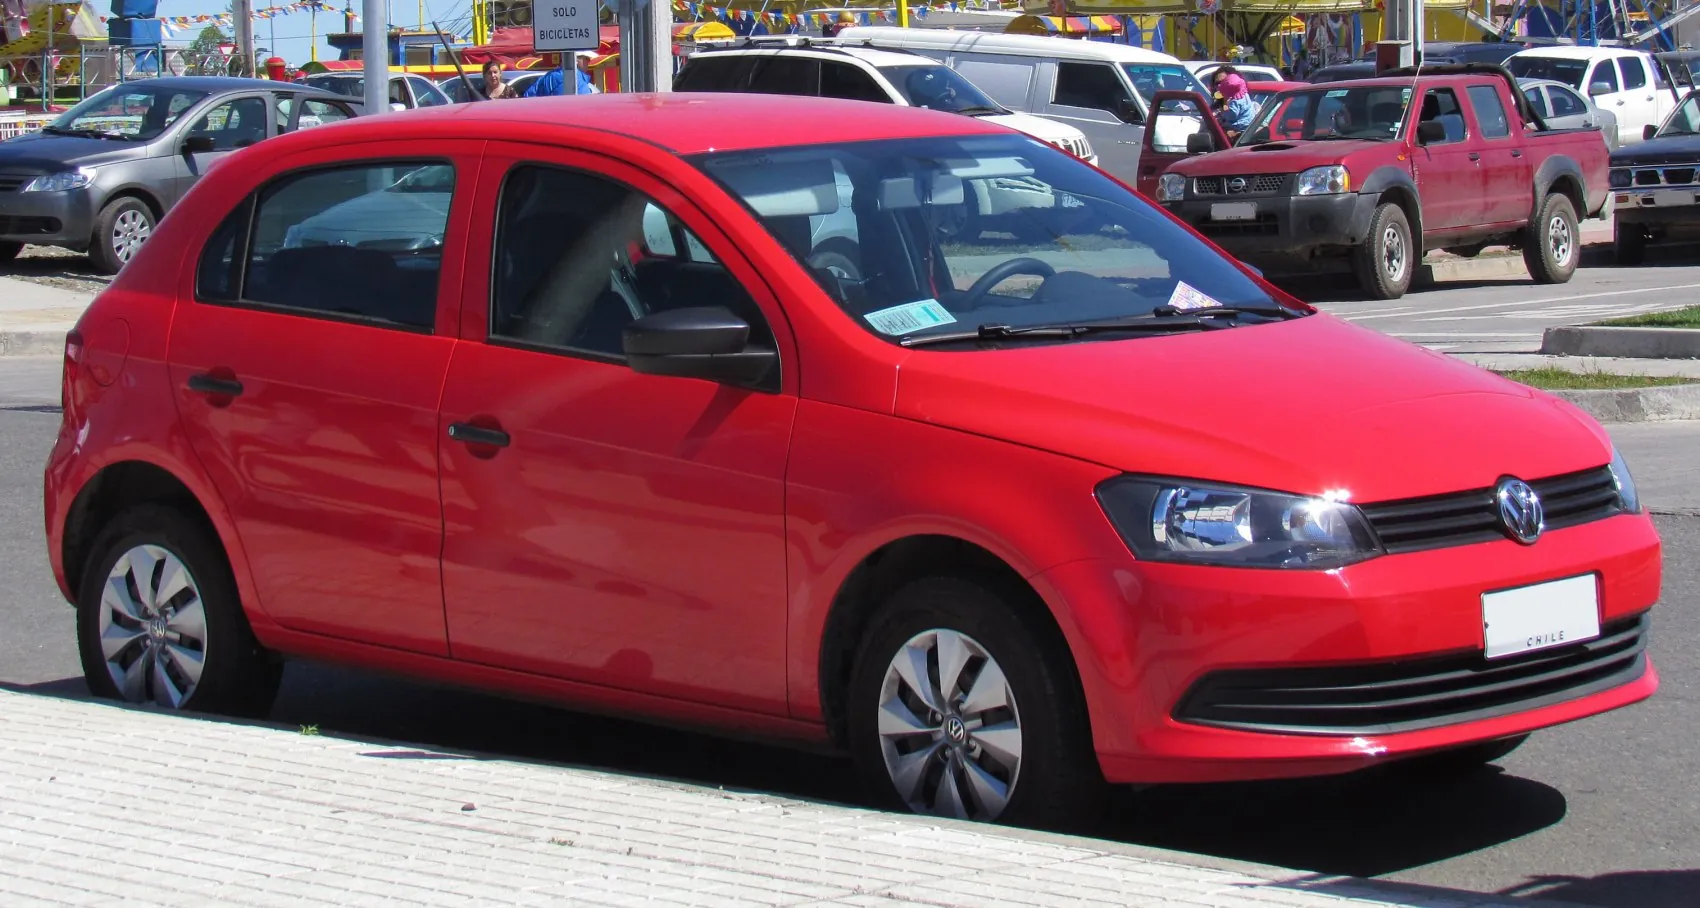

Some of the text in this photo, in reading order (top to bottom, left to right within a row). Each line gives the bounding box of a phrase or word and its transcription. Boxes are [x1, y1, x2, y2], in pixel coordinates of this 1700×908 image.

[552, 7, 577, 17] SOLO
[539, 28, 590, 40] BICICLETAS
[1526, 630, 1564, 647] CHILE
